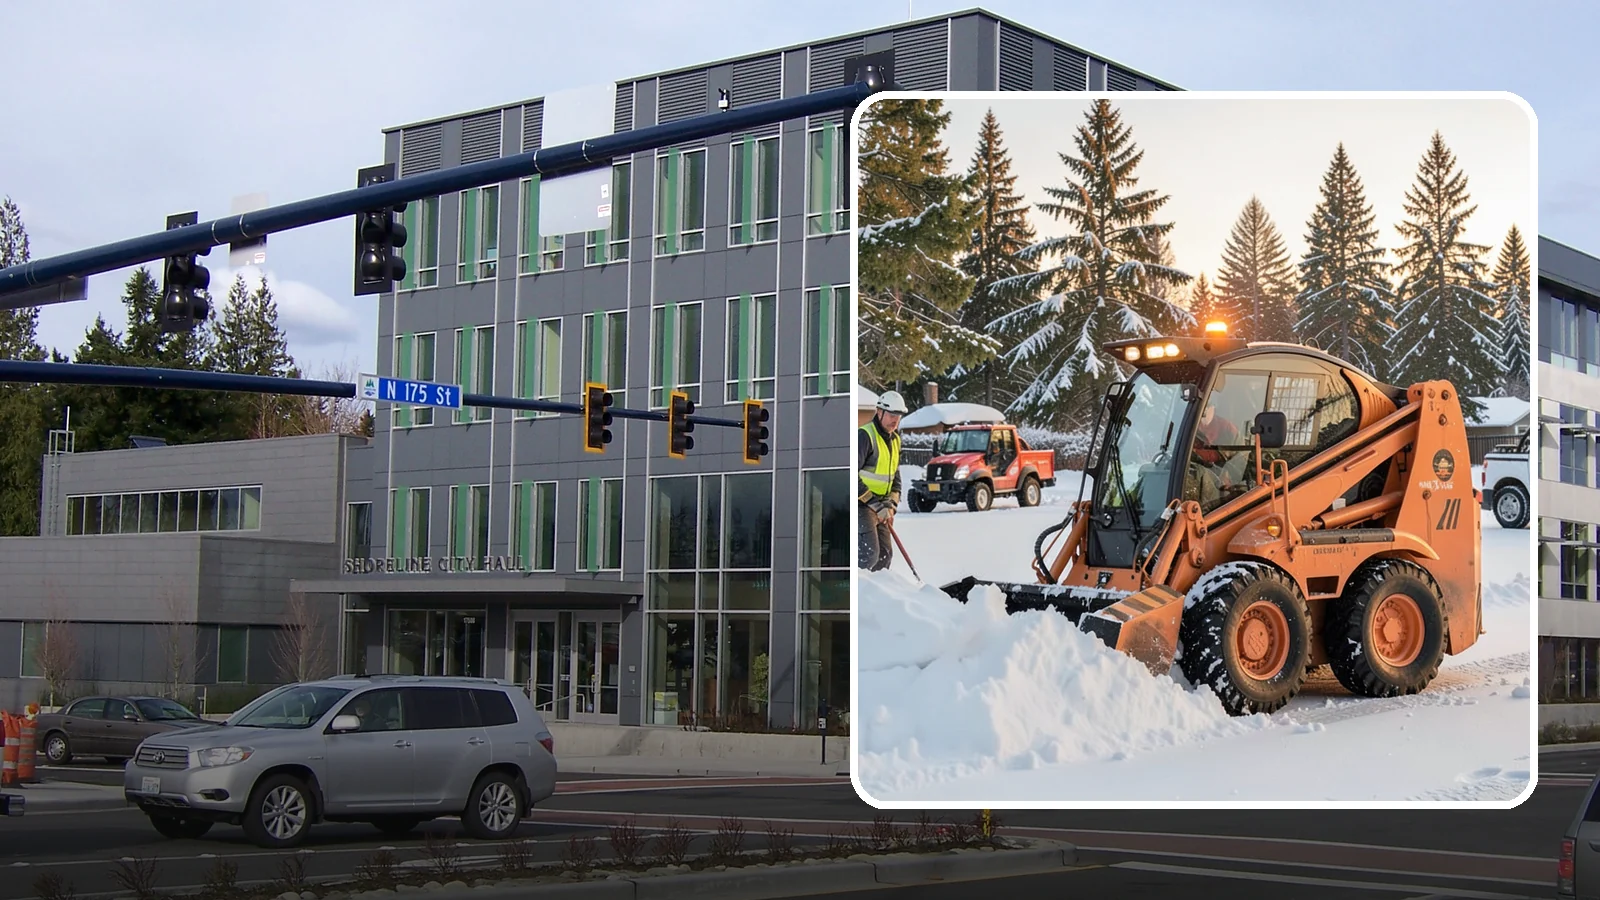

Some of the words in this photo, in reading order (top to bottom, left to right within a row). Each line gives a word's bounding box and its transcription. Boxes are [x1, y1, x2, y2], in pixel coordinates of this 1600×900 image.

[387, 381, 396, 399] N
[405, 383, 428, 403] 175
[436, 387, 451, 406] St
[344, 557, 431, 574] SHORELINE
[438, 557, 475, 572] CITY
[484, 556, 526, 571] HALL
